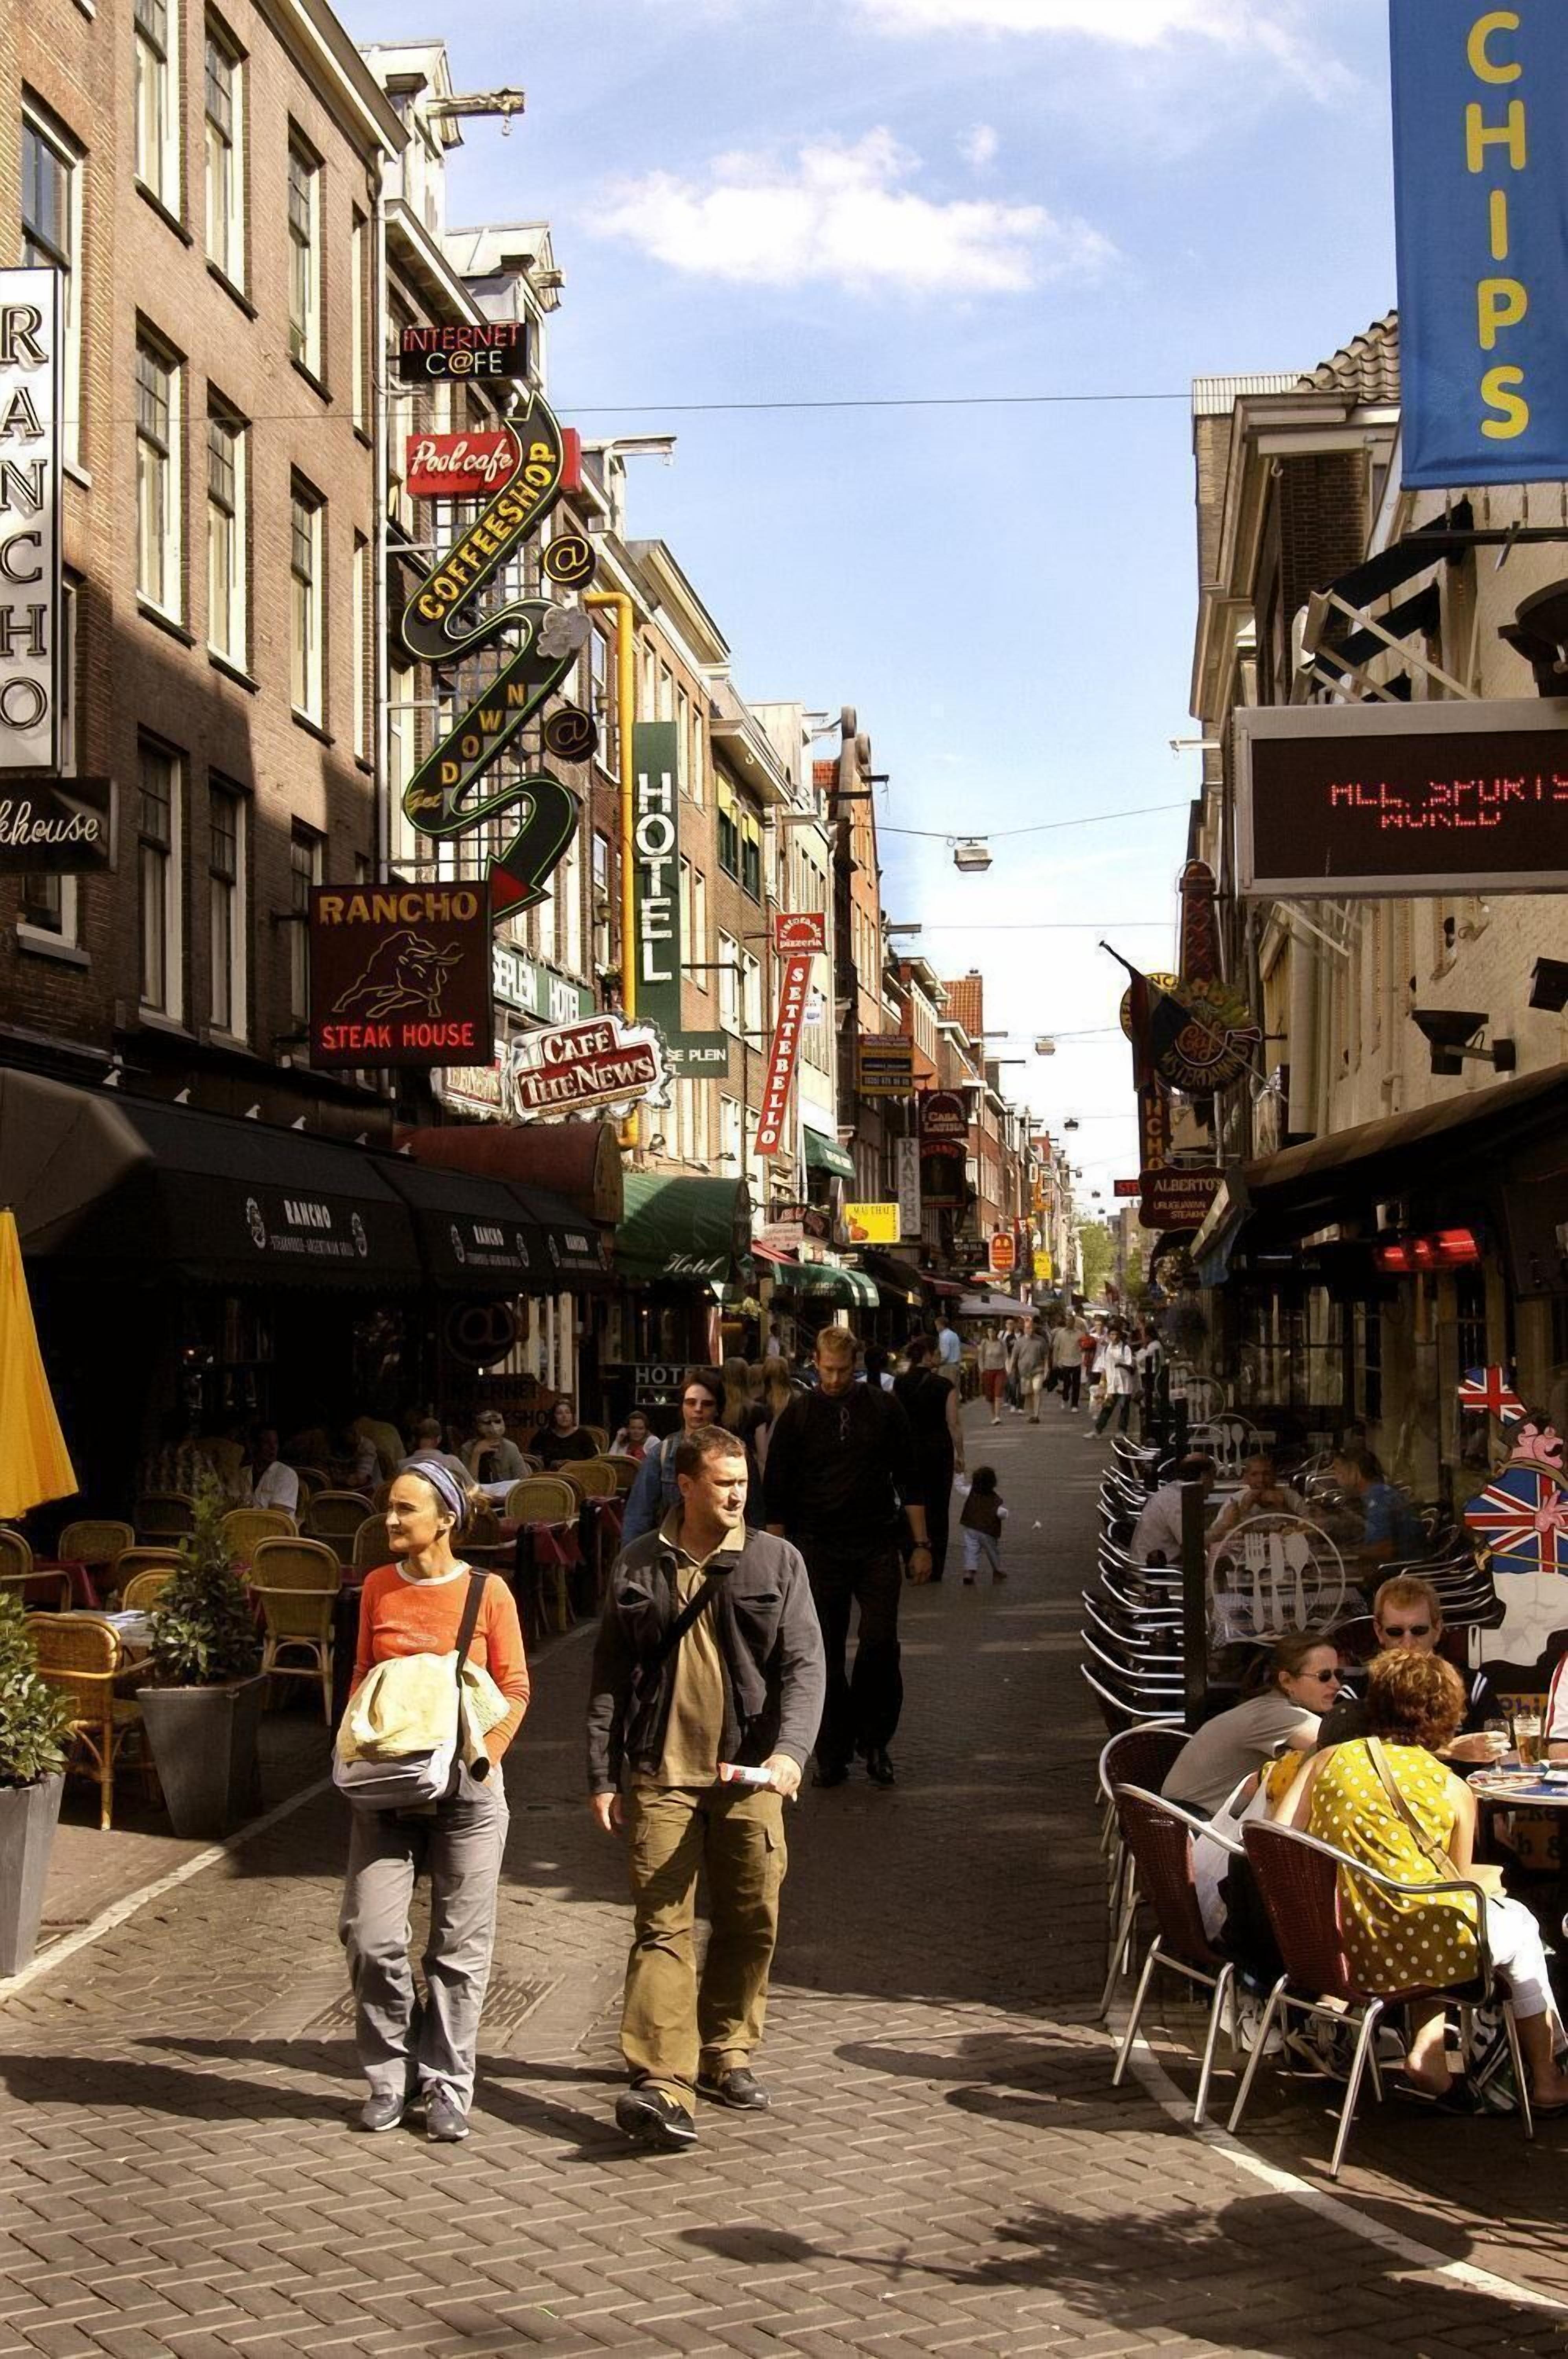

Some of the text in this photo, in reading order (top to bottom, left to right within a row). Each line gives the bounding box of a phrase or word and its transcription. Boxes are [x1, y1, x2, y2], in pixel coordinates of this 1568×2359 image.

[1466, 11, 1529, 439] CHIPS
[403, 322, 520, 352] INTERNET
[426, 350, 502, 375] C@FE
[410, 438, 514, 483] Pool cafe
[0, 303, 49, 732] RANCHO
[418, 441, 556, 622] COFFEESHOP
[441, 682, 525, 784] DOWN
[405, 789, 444, 816] Get
[636, 773, 675, 981] HOTEL
[319, 890, 478, 925] RANCHO
[780, 939, 822, 949] pizzeria
[322, 1023, 474, 1049] STEAK HOUSE
[688, 1048, 726, 1062] PLEIN
[761, 967, 804, 1145] SETTEBELLO
[571, 1056, 656, 1094] NEWS
[902, 1141, 916, 1232] RANCHO
[283, 1200, 331, 1228] RANCHO
[663, 1253, 724, 1274] Hotel
[636, 1366, 698, 1384] HOT
